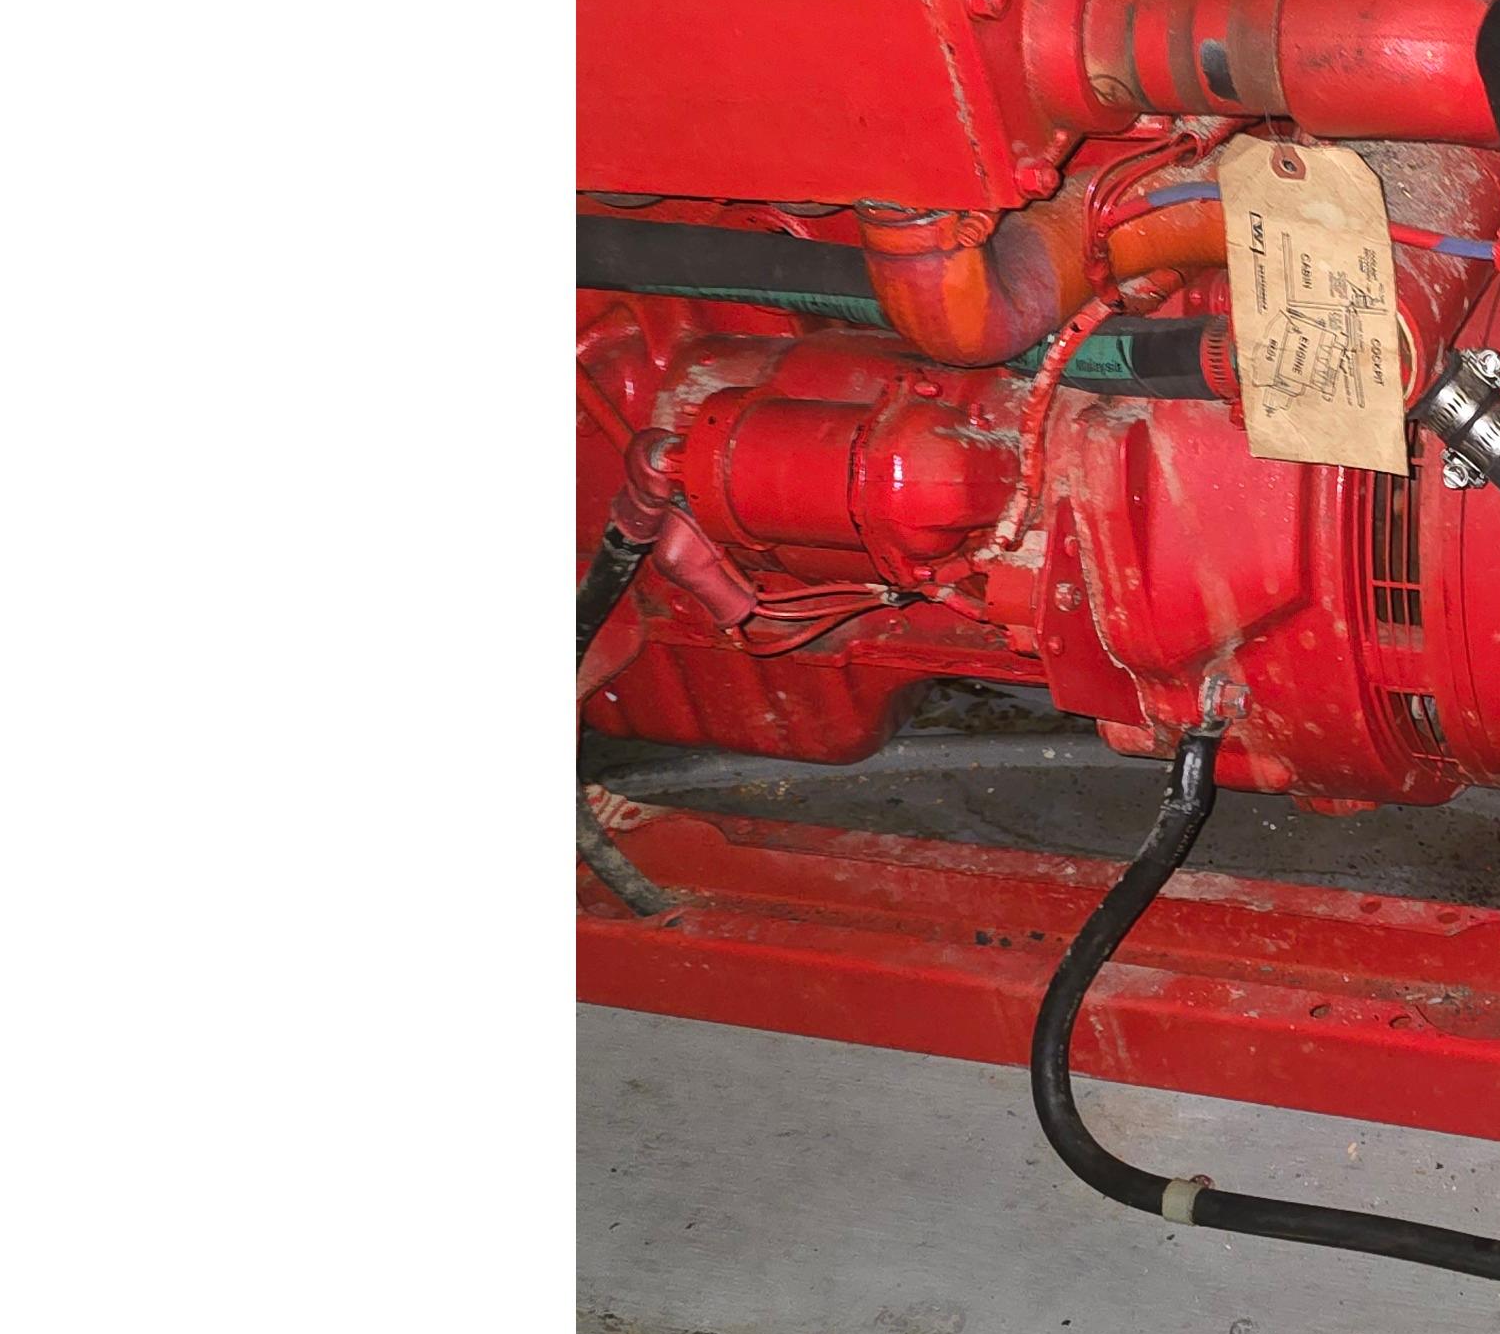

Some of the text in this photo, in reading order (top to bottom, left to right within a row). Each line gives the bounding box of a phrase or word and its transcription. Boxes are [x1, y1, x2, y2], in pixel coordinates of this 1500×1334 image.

[1299, 253, 1313, 290] CABIN
[1292, 335, 1308, 376] ENGINE
[1371, 338, 1385, 386] COCKPIT
